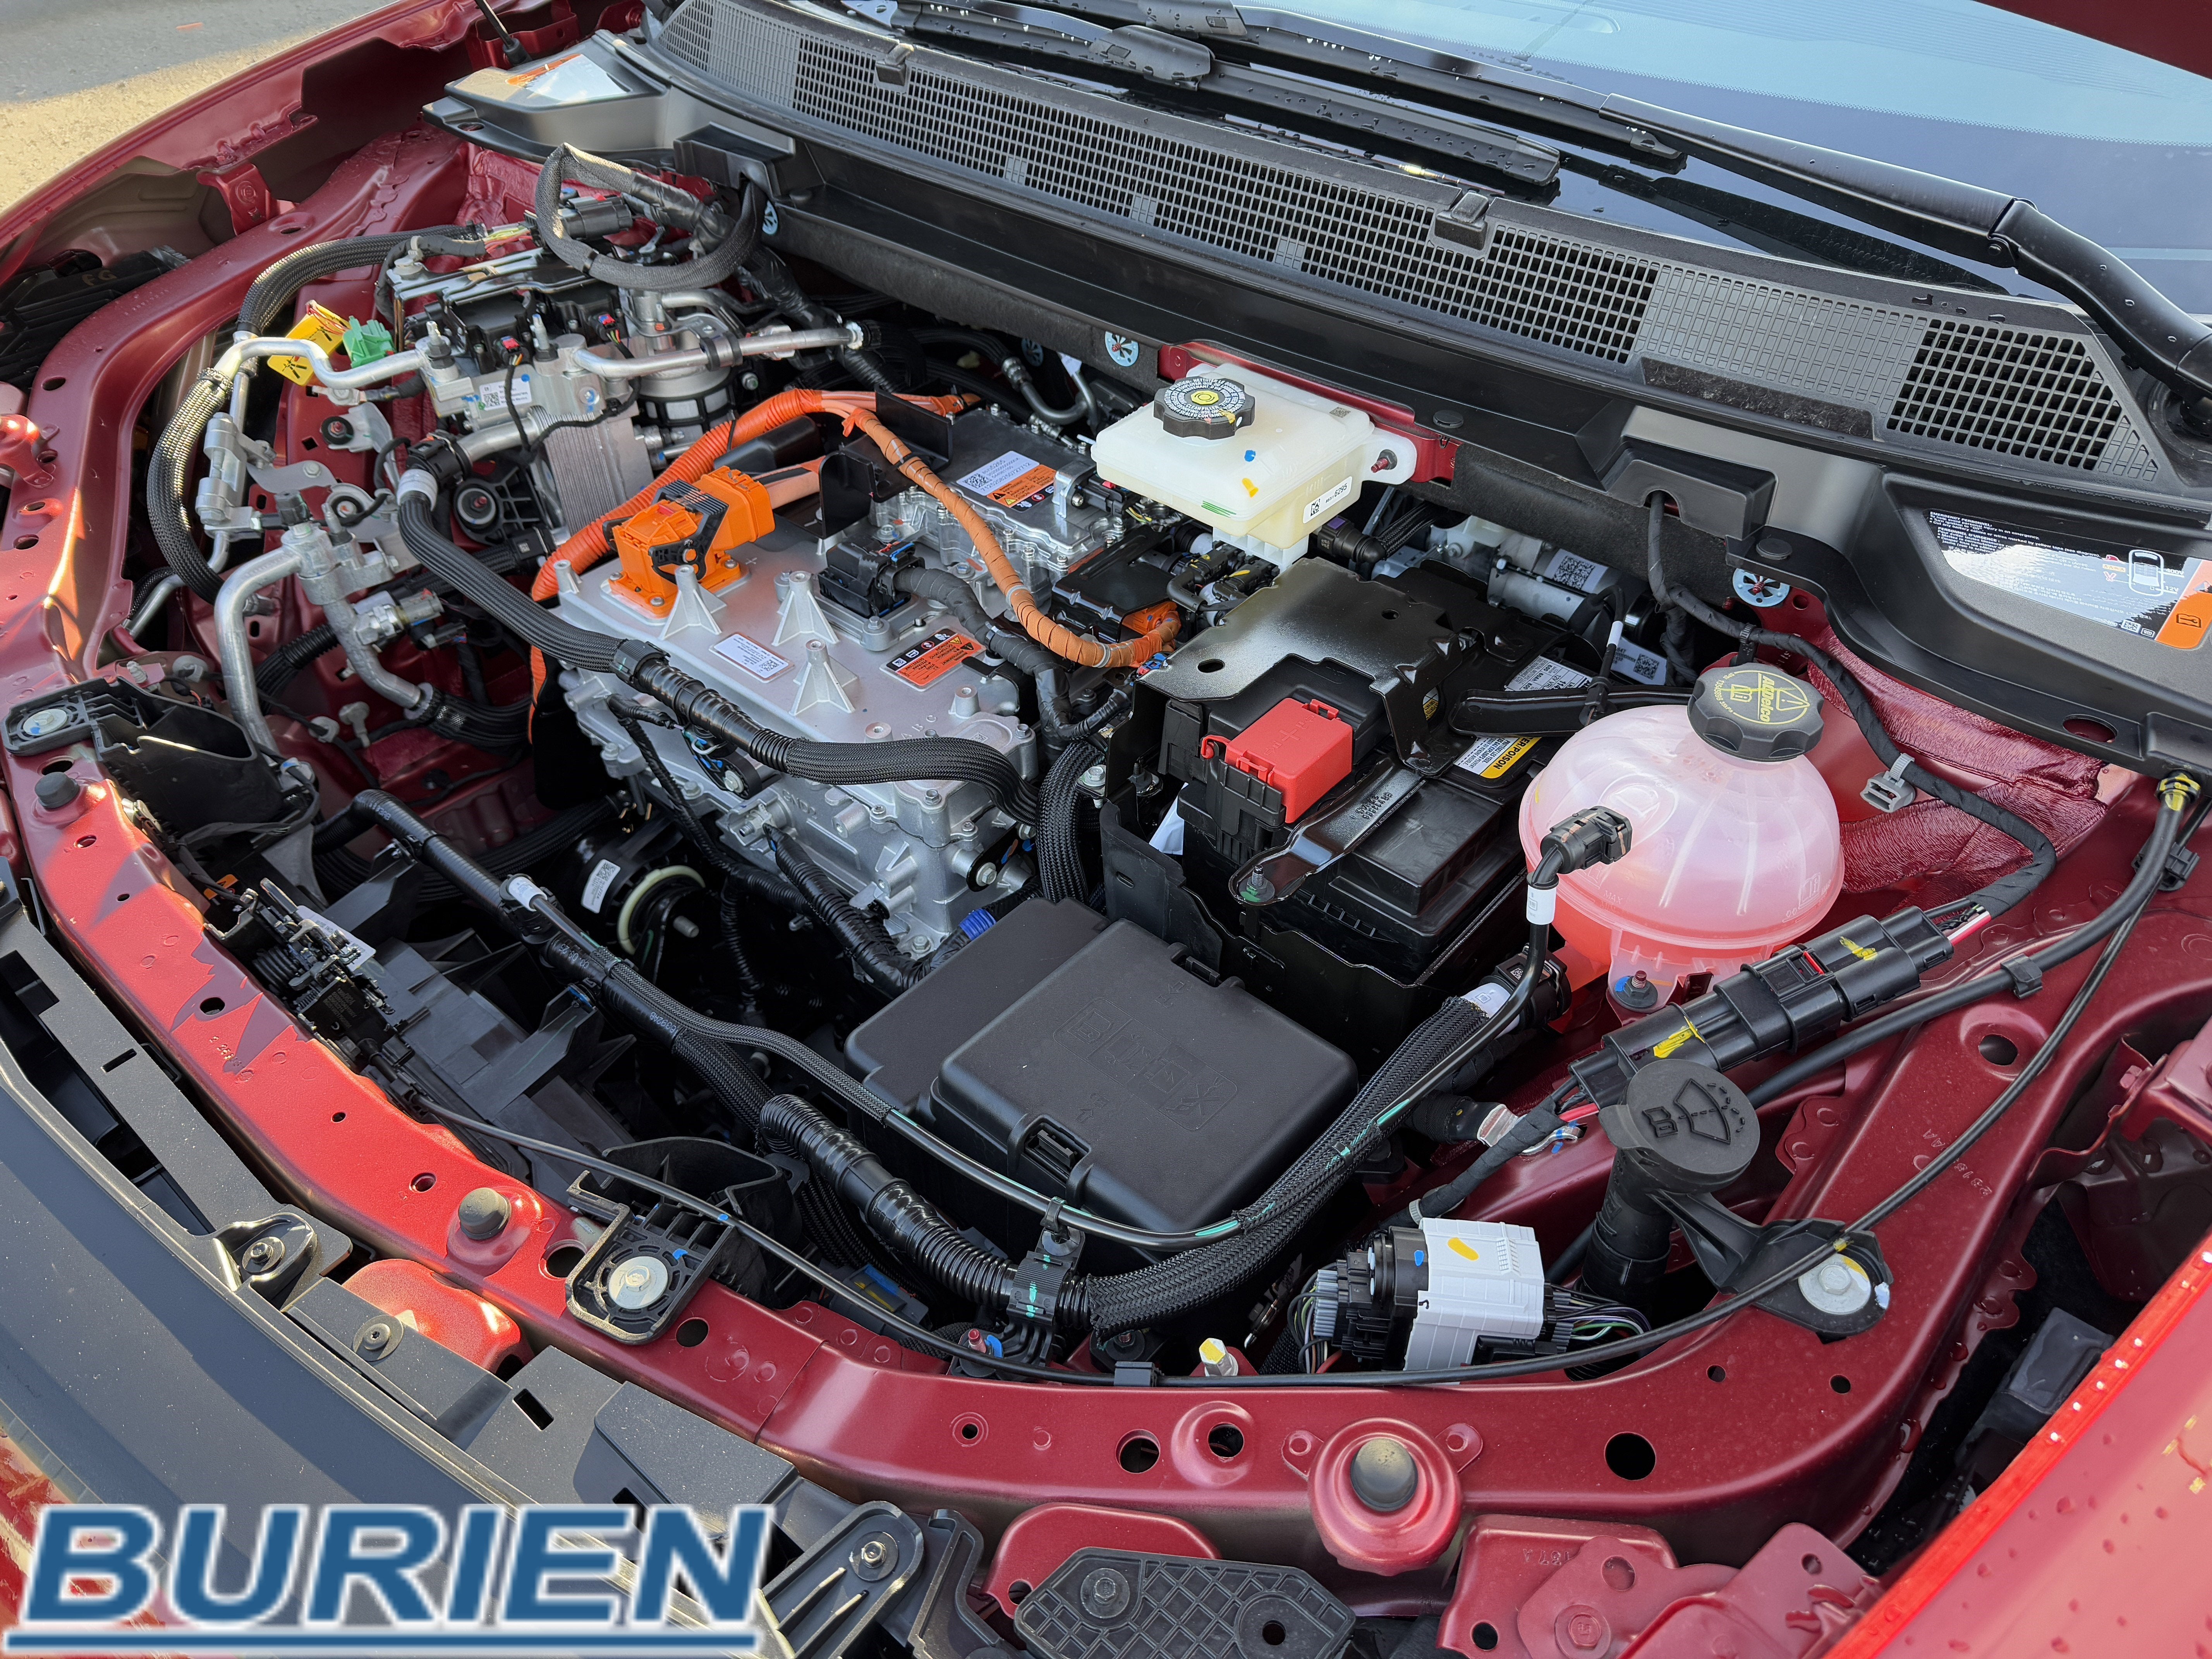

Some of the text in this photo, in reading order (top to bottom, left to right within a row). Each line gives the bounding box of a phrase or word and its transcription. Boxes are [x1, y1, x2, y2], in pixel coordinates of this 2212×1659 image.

[1334, 483, 1347, 497] 6295
[1930, 511, 1960, 520] EMERGENCY
[1938, 527, 1967, 536] PERSONNEL
[1968, 533, 1997, 542] D'URGENCE
[1760, 675, 1775, 722] ACDelco
[1603, 890, 1623, 905] MAX
